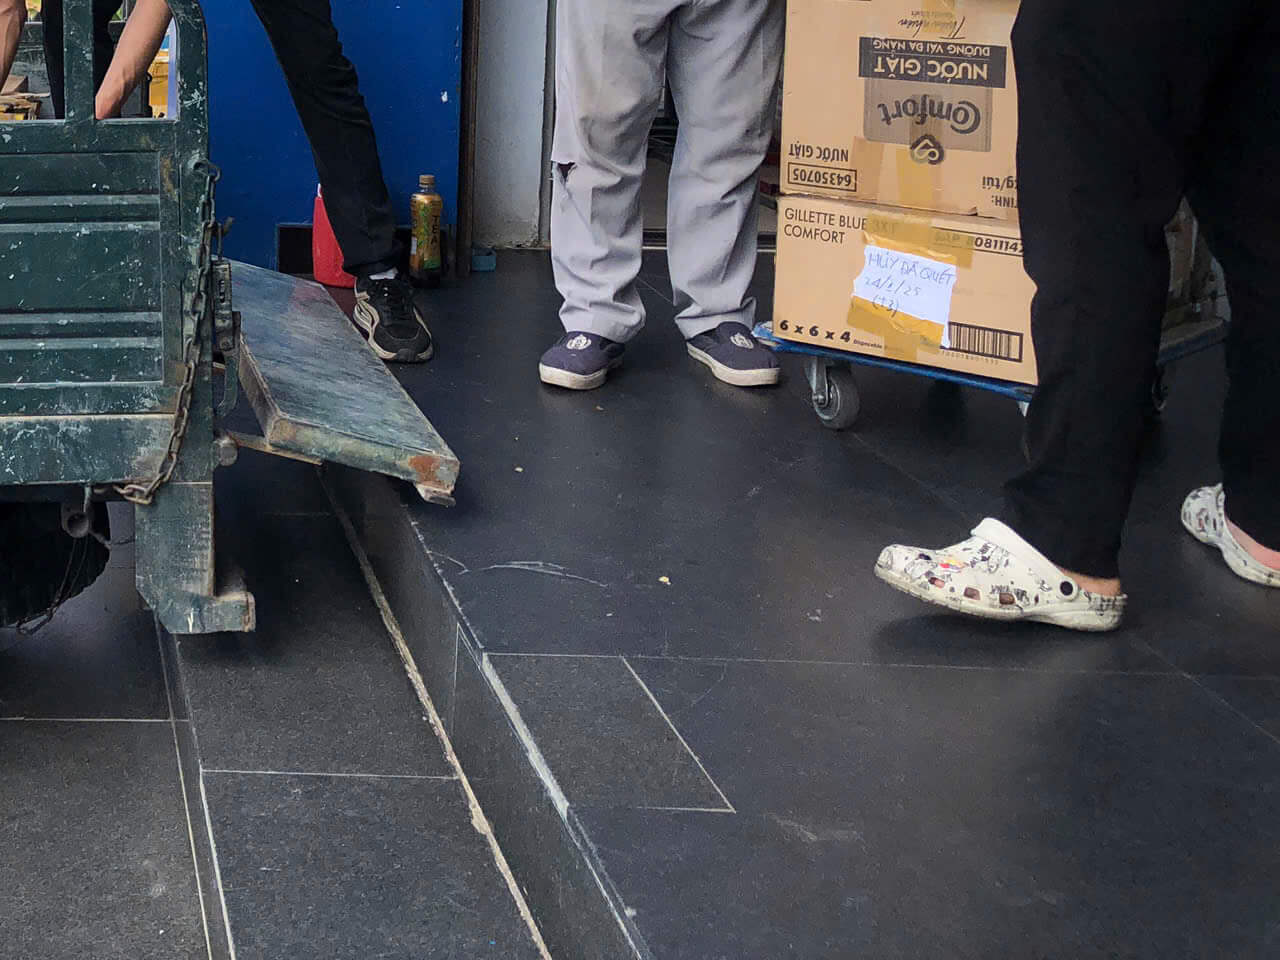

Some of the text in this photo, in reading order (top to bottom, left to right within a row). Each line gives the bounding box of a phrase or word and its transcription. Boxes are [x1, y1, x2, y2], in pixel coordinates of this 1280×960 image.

[873, 51, 988, 83] NƯỚC GIẶT
[877, 95, 981, 135] Comfort
[789, 140, 849, 162] NƯỚC GIẶT
[792, 168, 852, 186] 64350705
[784, 207, 836, 226] GILLETTE
[839, 215, 868, 230] BLUE
[784, 224, 846, 244] COMFORT
[779, 319, 789, 331] 6
[809, 325, 819, 337] 6
[840, 330, 851, 343] 4
